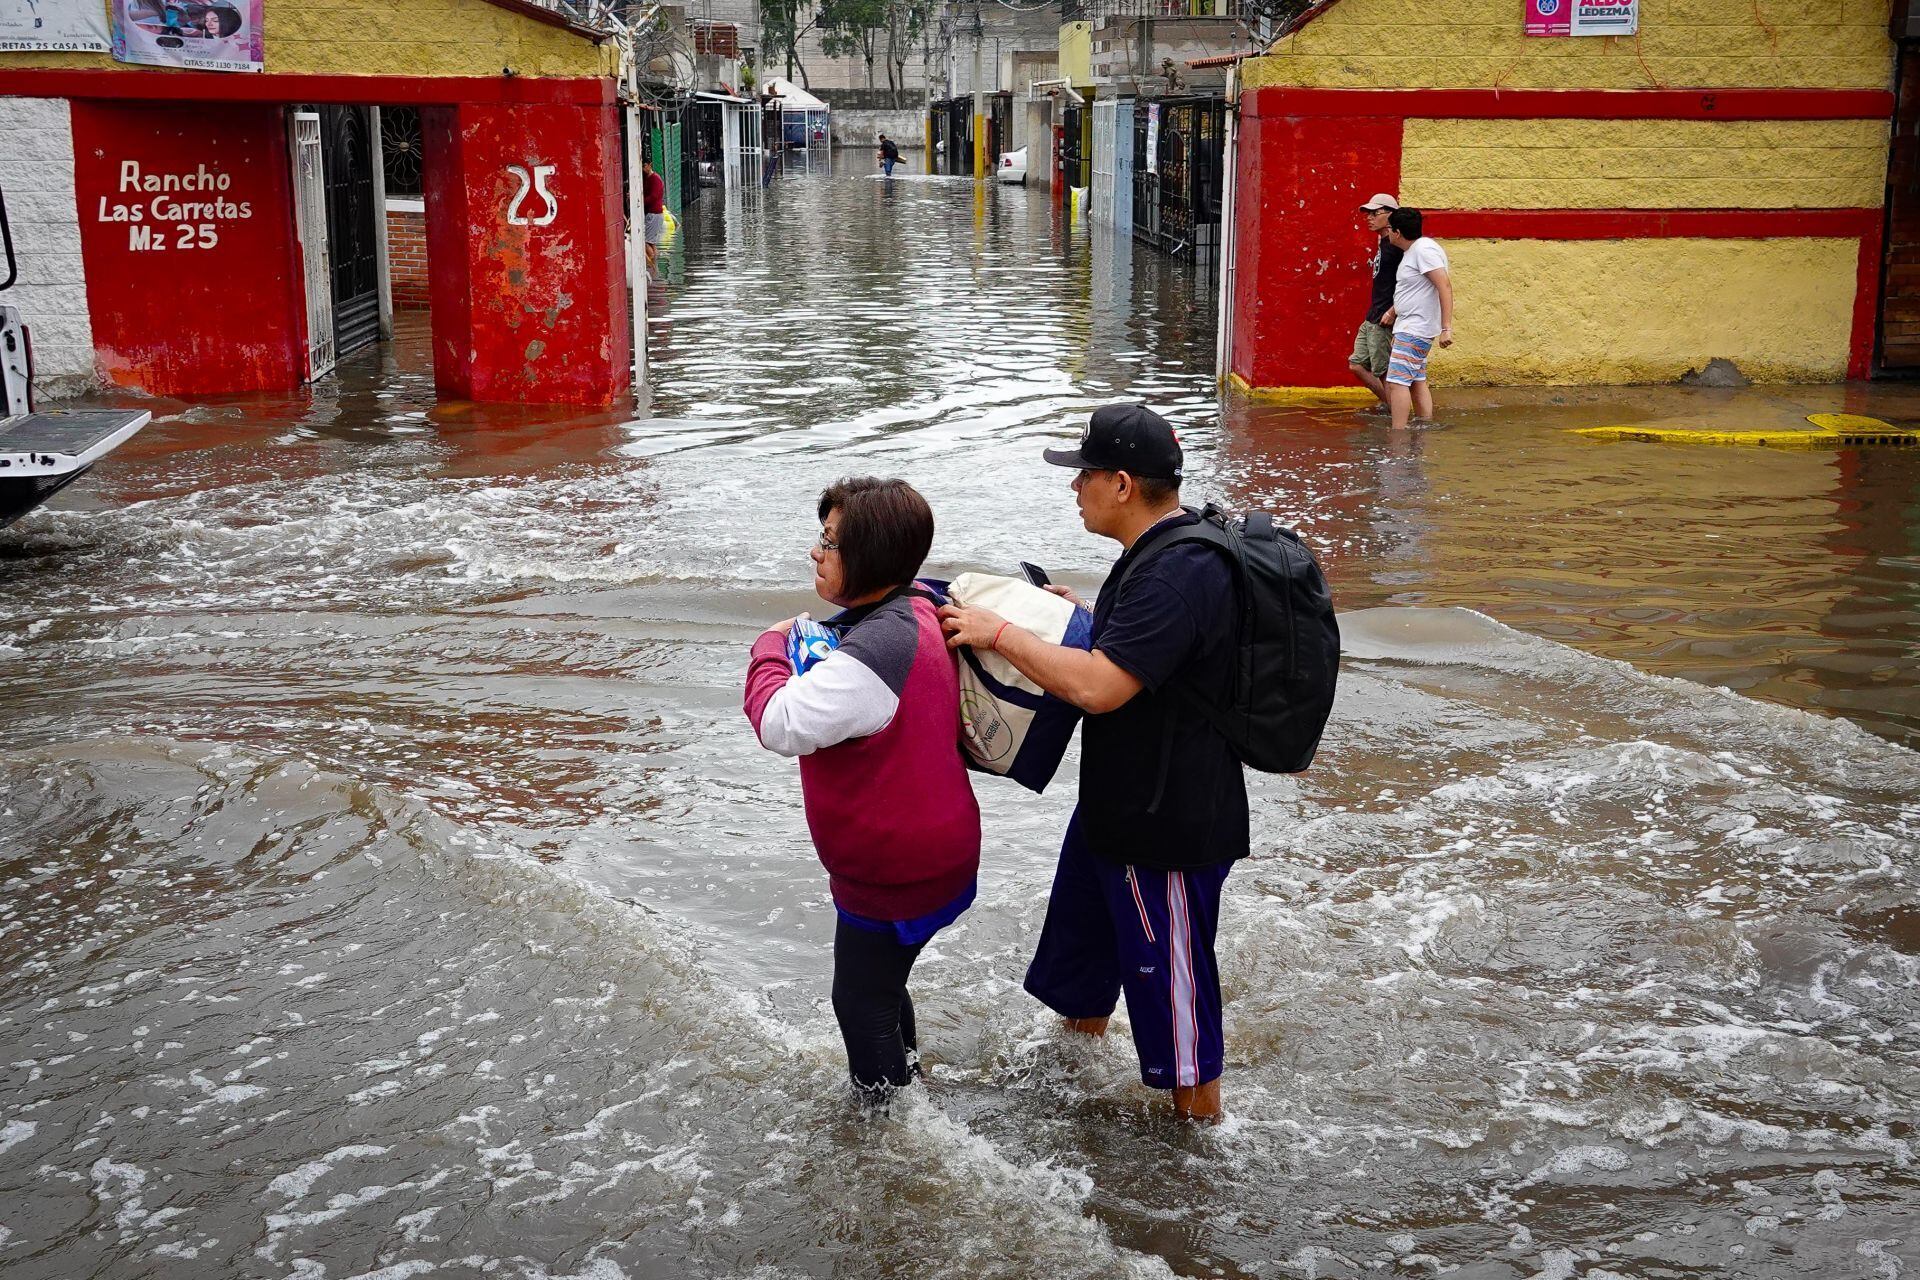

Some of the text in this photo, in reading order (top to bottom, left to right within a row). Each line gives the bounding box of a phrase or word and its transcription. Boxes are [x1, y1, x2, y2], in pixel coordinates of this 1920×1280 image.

[1579, 7, 1631, 16] LEDEZMA
[36, 42, 48, 50] 25
[52, 42, 78, 50] CASA
[82, 42, 102, 50] 14B
[183, 59, 250, 70] CITAS: 55 1130 7184
[119, 160, 231, 192] Rancho
[98, 195, 253, 222] Las Carretas
[506, 164, 558, 226] 25
[129, 224, 219, 251] Mz 25
